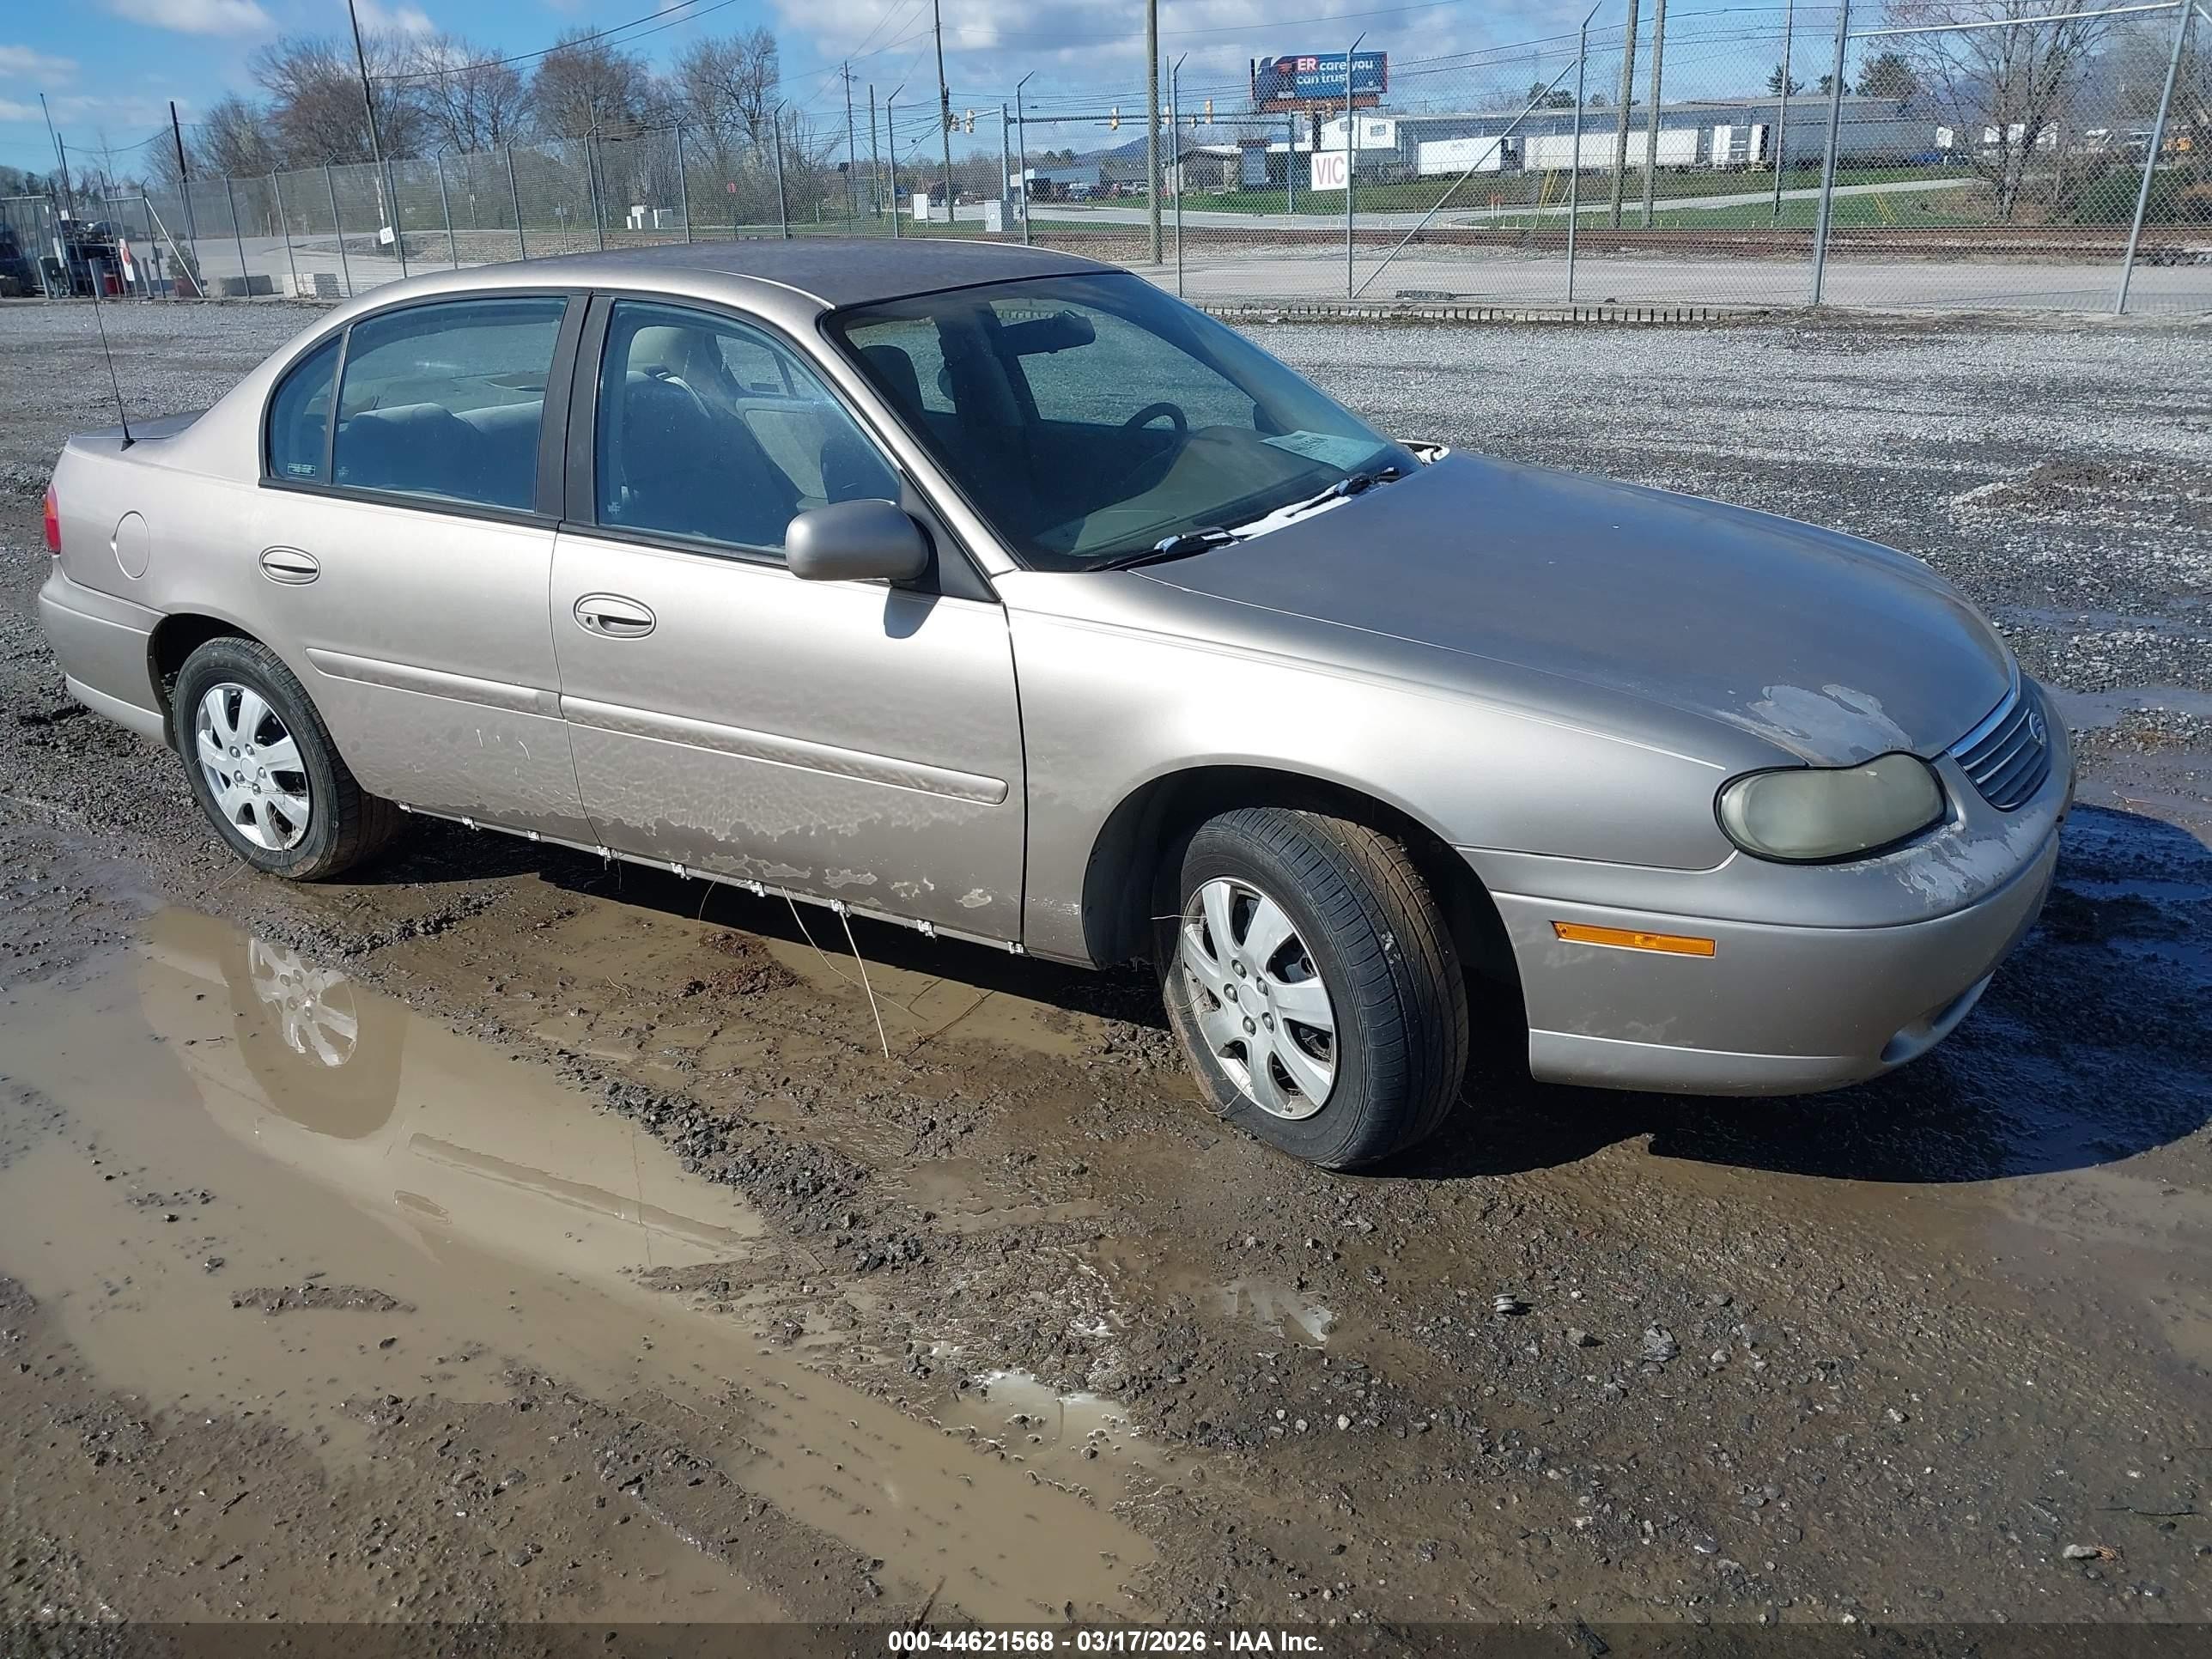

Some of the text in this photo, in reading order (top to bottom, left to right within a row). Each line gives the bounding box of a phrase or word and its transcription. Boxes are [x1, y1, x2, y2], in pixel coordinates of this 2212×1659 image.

[1297, 58, 1373, 70] ER care you
[1297, 76, 1319, 84] can
[1316, 156, 1344, 184] VIC
